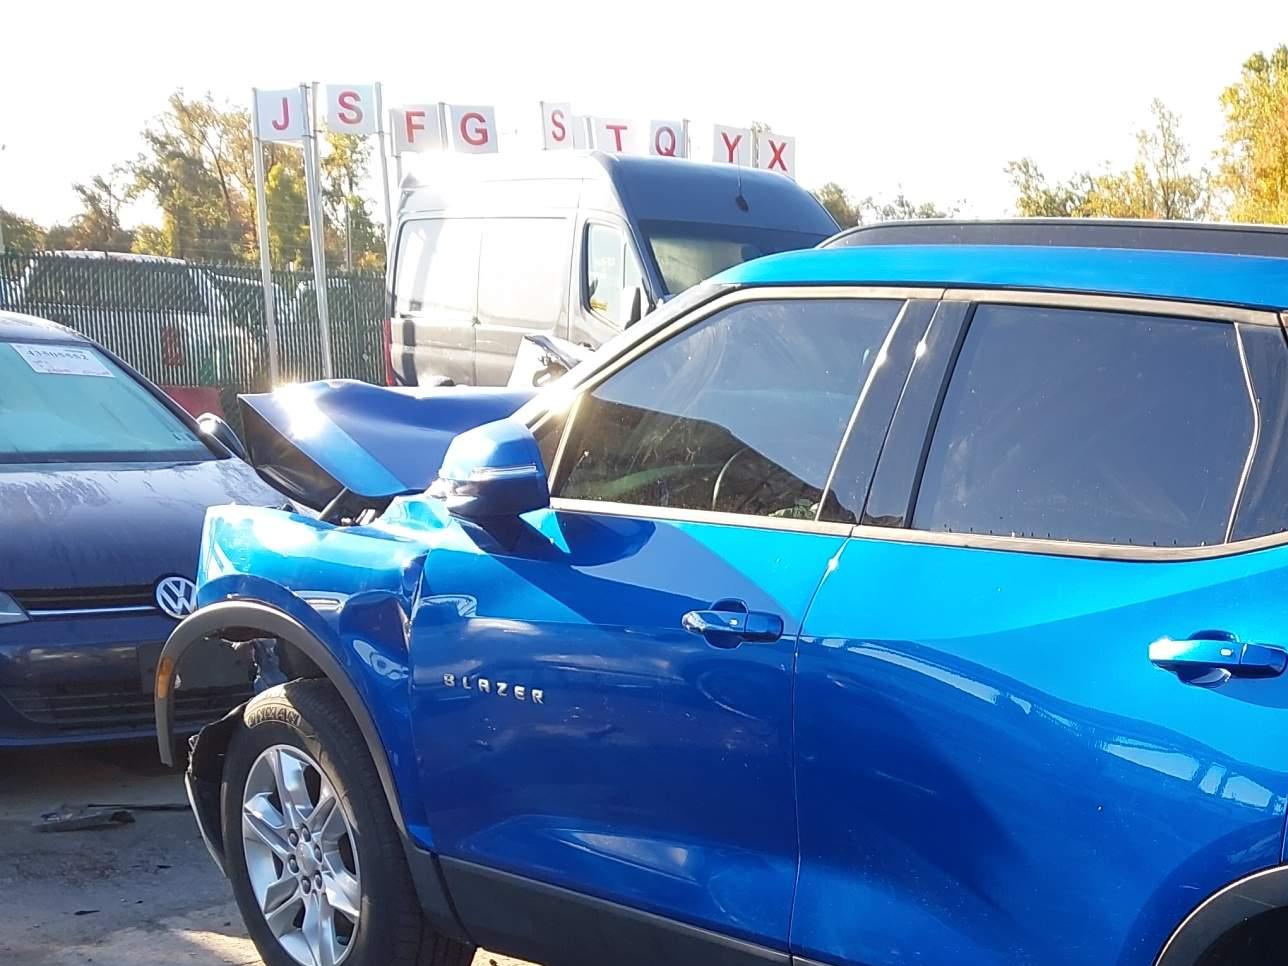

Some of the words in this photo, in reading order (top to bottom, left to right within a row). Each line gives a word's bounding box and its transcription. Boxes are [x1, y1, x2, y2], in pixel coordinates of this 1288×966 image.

[271, 96, 290, 131] J
[337, 90, 364, 125] S
[405, 110, 426, 144] F
[459, 111, 489, 146] G
[551, 108, 567, 142] S
[605, 124, 628, 153] T
[654, 125, 677, 158] Q
[721, 131, 743, 164] Y
[767, 139, 788, 172] X
[442, 672, 545, 705] BLAZER
